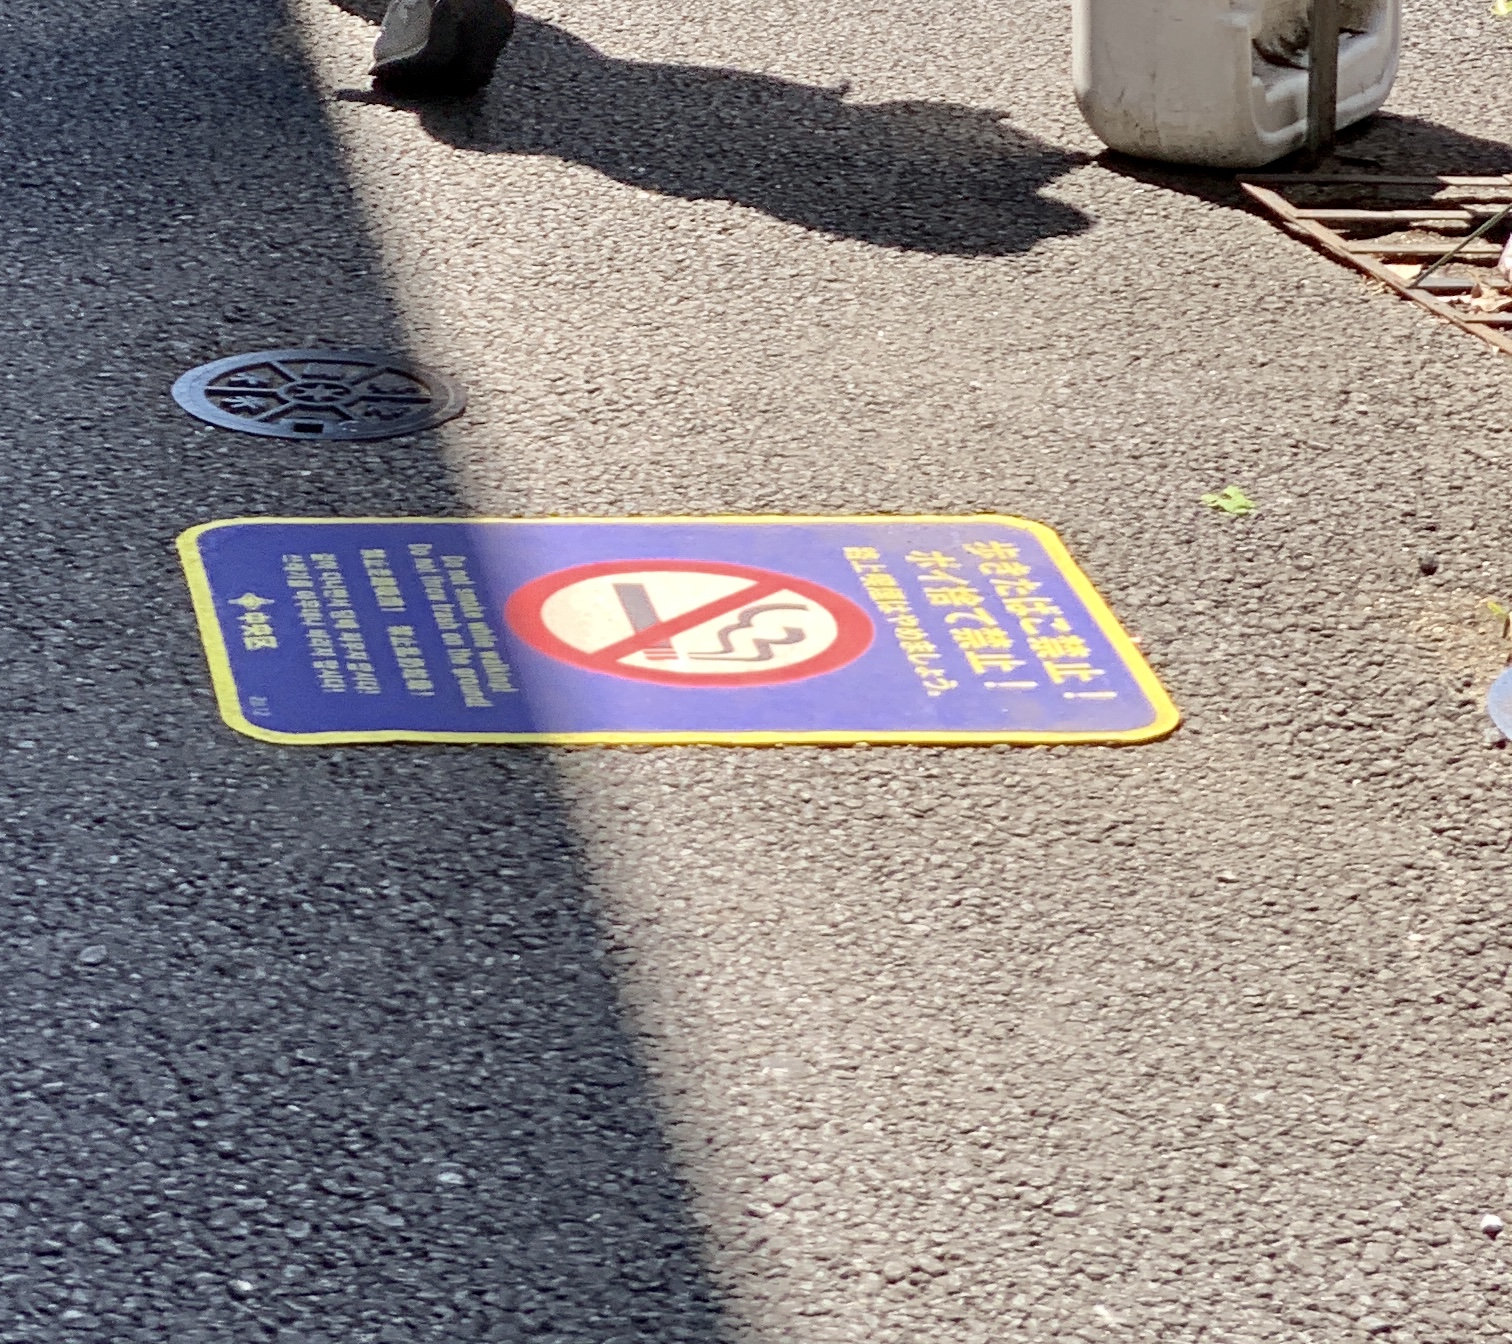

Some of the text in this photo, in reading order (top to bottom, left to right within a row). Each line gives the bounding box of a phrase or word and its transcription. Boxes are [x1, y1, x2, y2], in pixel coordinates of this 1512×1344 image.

[239, 611, 277, 650] 中央区
[407, 543, 492, 708] Do not throw trash on the ground!
[440, 555, 516, 693] Do not smoke while walking!
[906, 549, 1036, 688] ポイ捨て禁止！
[962, 539, 1116, 700] 歩きたばこ禁止！
